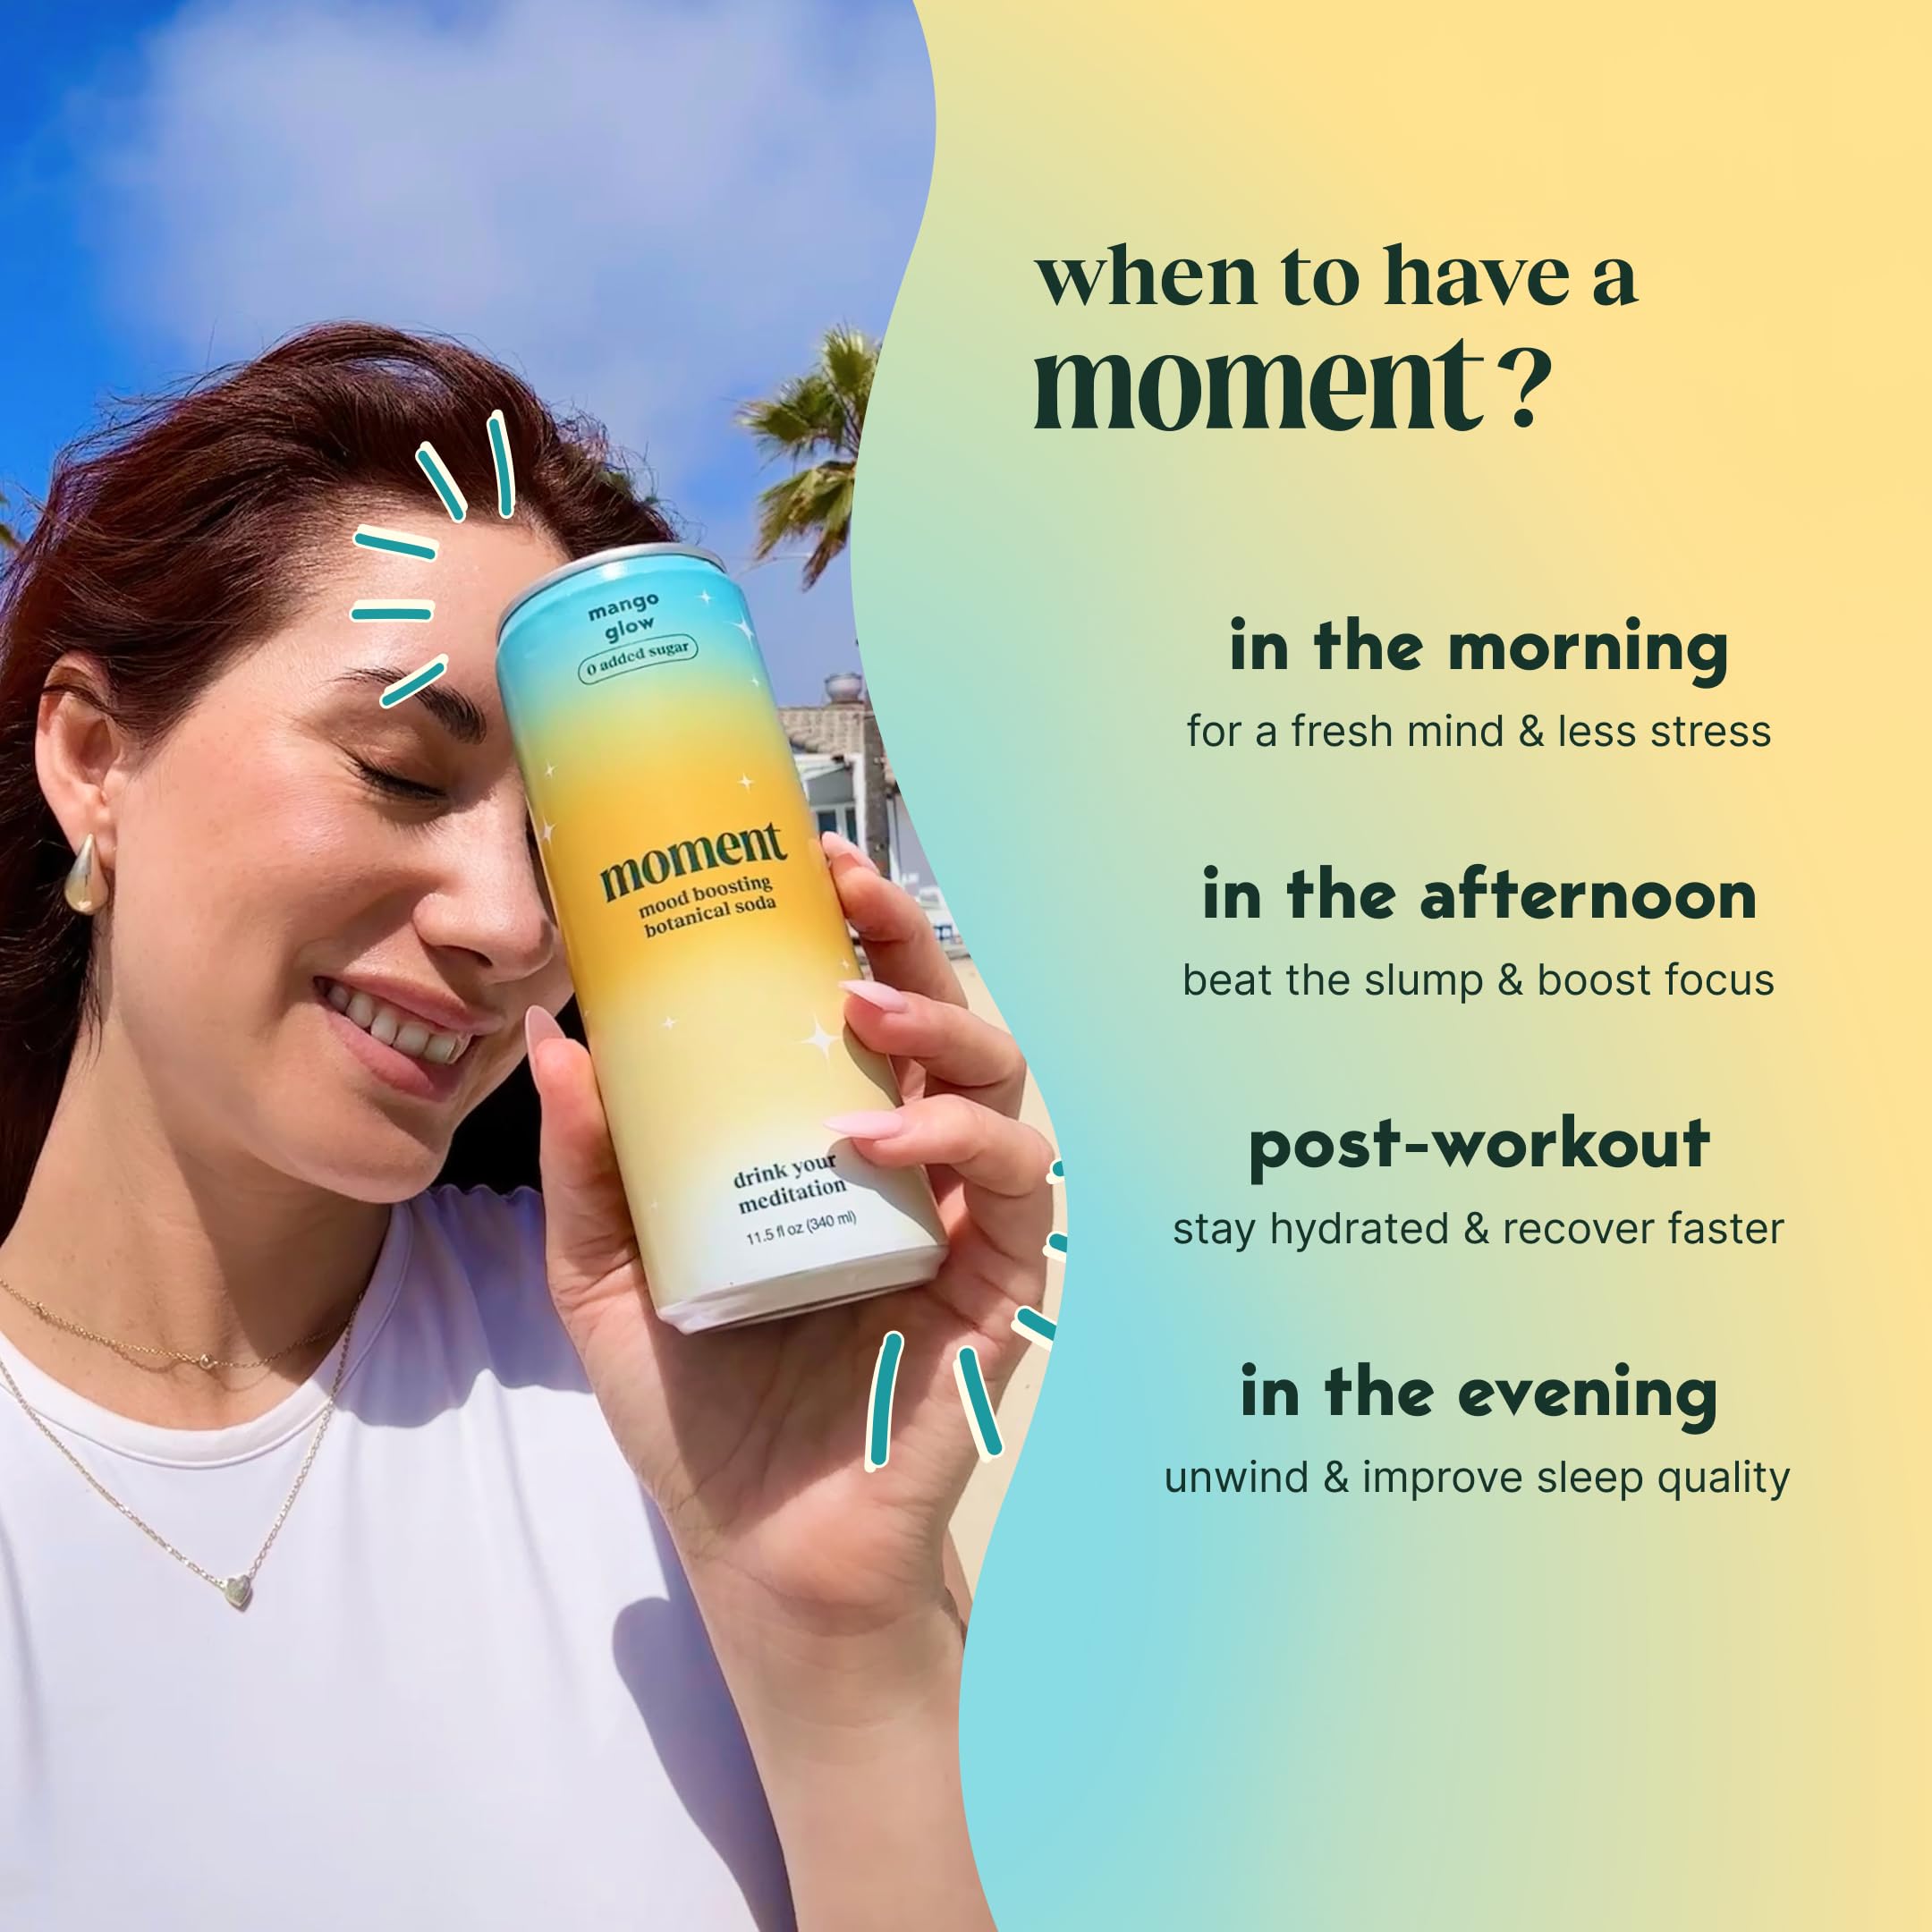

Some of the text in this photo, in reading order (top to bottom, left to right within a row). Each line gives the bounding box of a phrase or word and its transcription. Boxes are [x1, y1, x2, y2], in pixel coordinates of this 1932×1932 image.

[588, 593, 659, 621] mango
[605, 617, 655, 644] glow
[587, 642, 689, 676] 0 added sugar
[599, 821, 788, 902] moment
[639, 876, 773, 919] mood boosting
[644, 895, 776, 938] botanical soda
[733, 1154, 836, 1189] drink your
[739, 1179, 847, 1215] meditation
[746, 1210, 857, 1245] 11.5 fl oz (340 ml)
